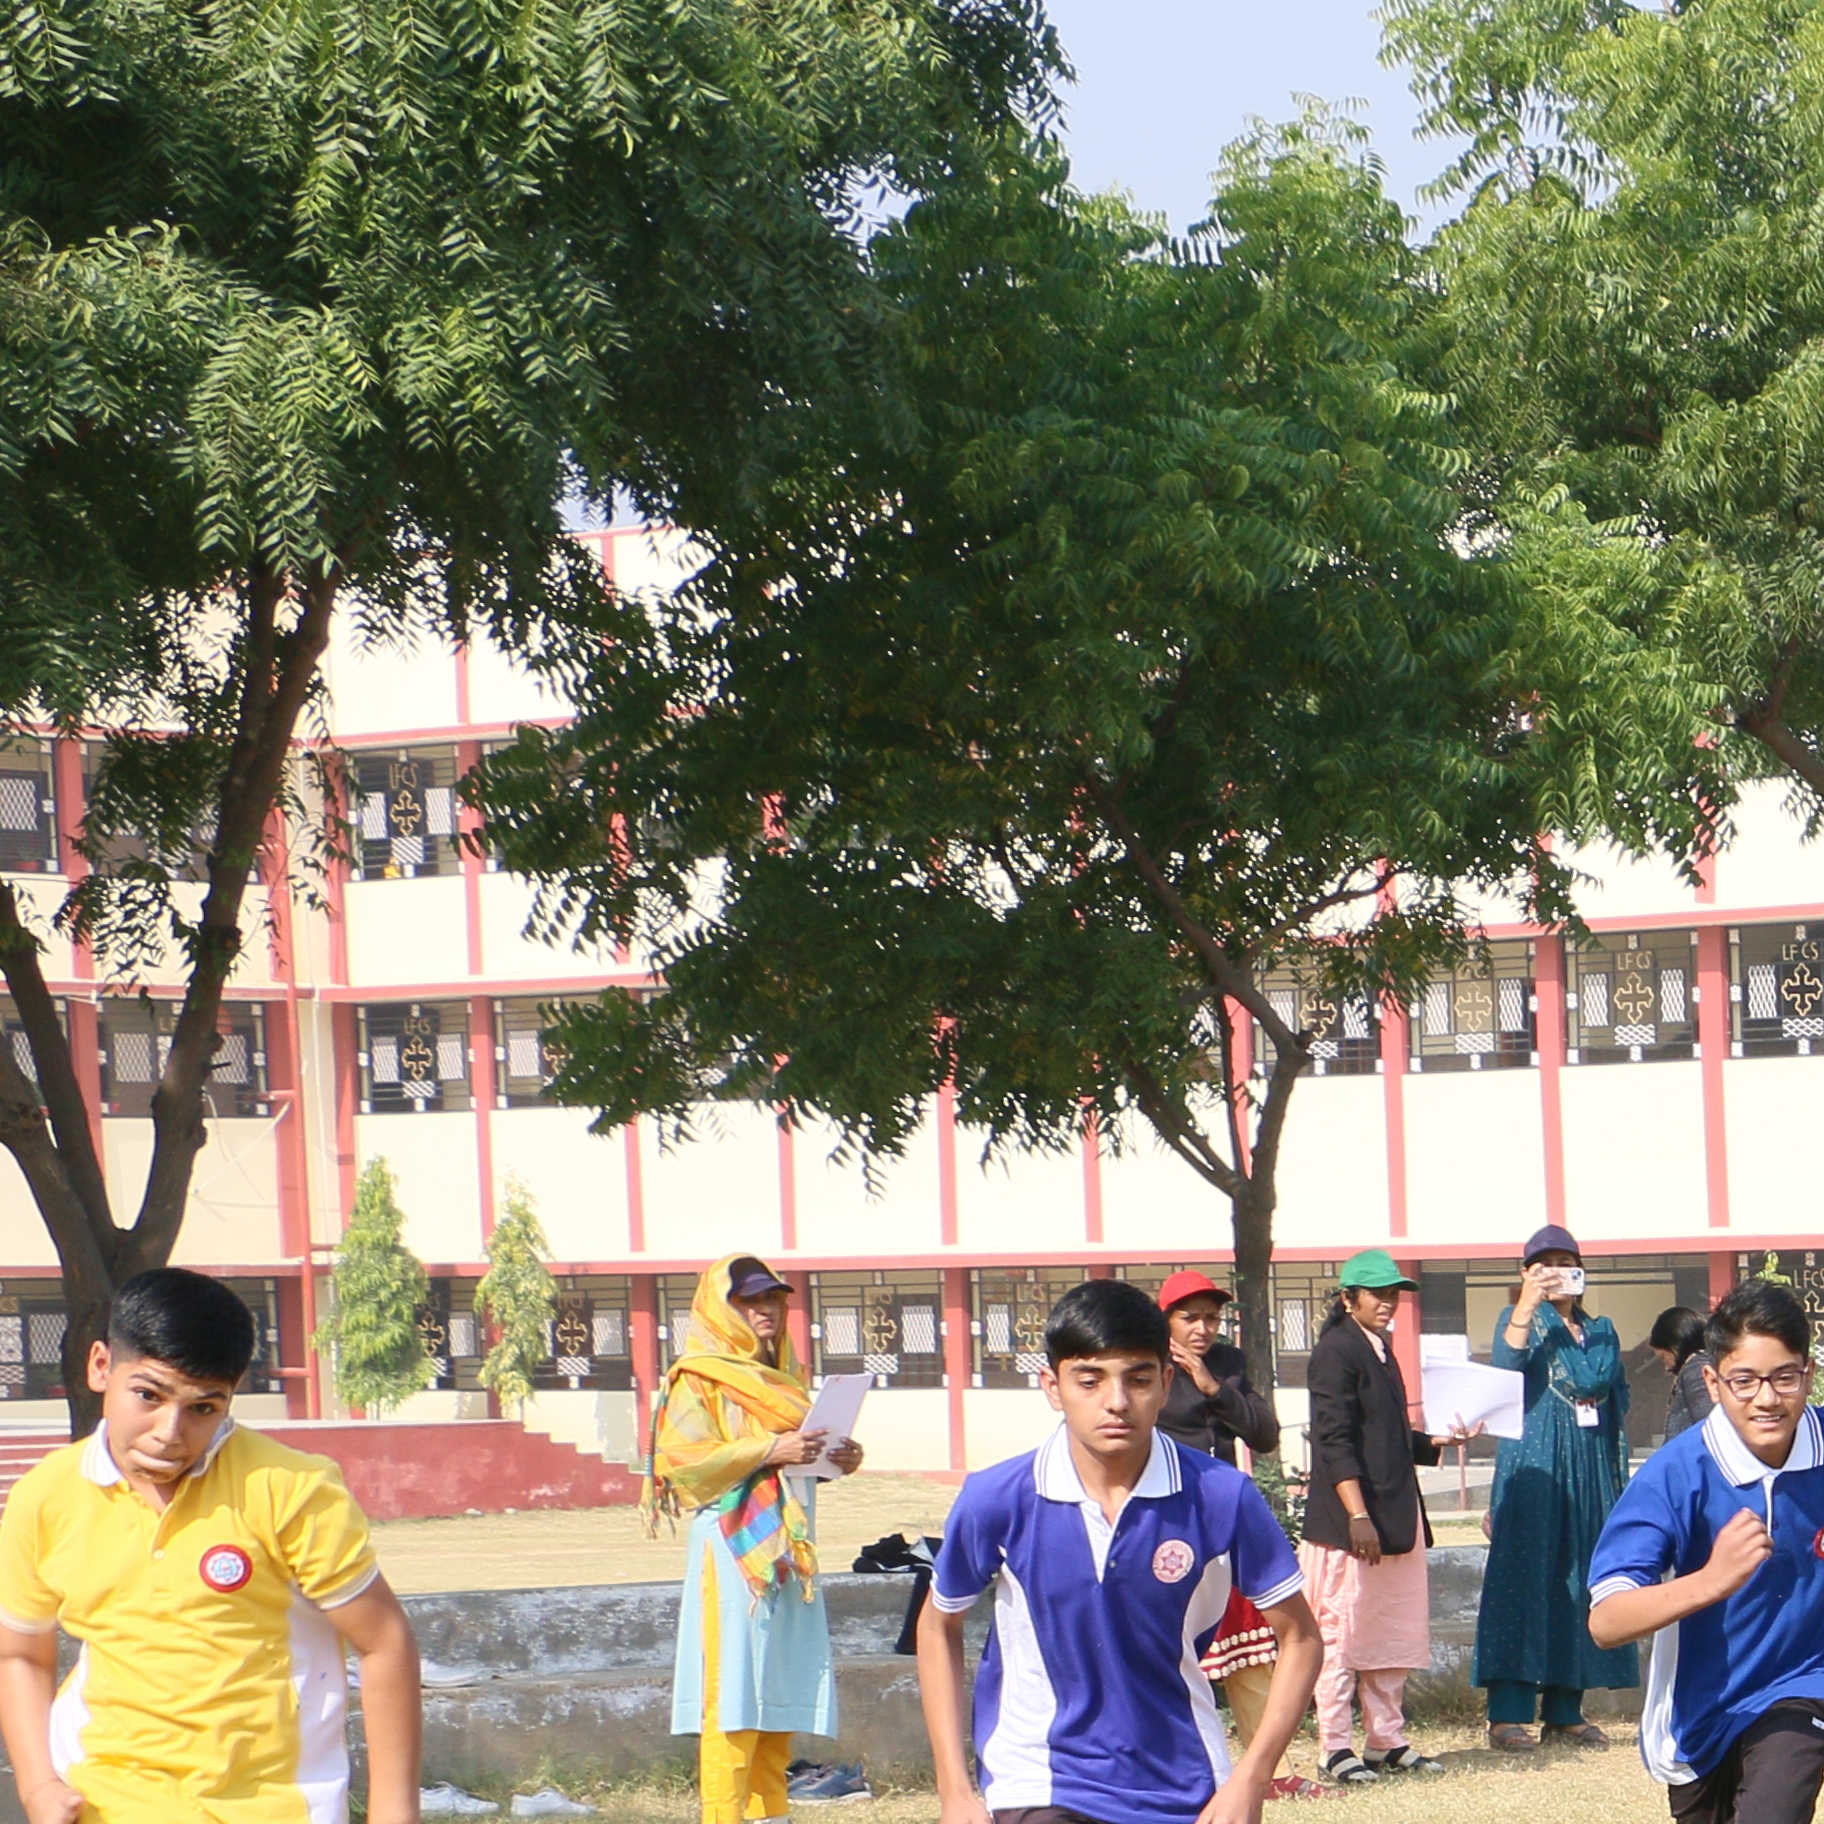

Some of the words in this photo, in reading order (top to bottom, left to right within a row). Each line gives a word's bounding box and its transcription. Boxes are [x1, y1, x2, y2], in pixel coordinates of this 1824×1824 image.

[388, 762, 418, 789] LFCS
[1616, 950, 1652, 971] LFCS
[1781, 942, 1819, 961] LFCS
[403, 1017, 432, 1035] LFCS
